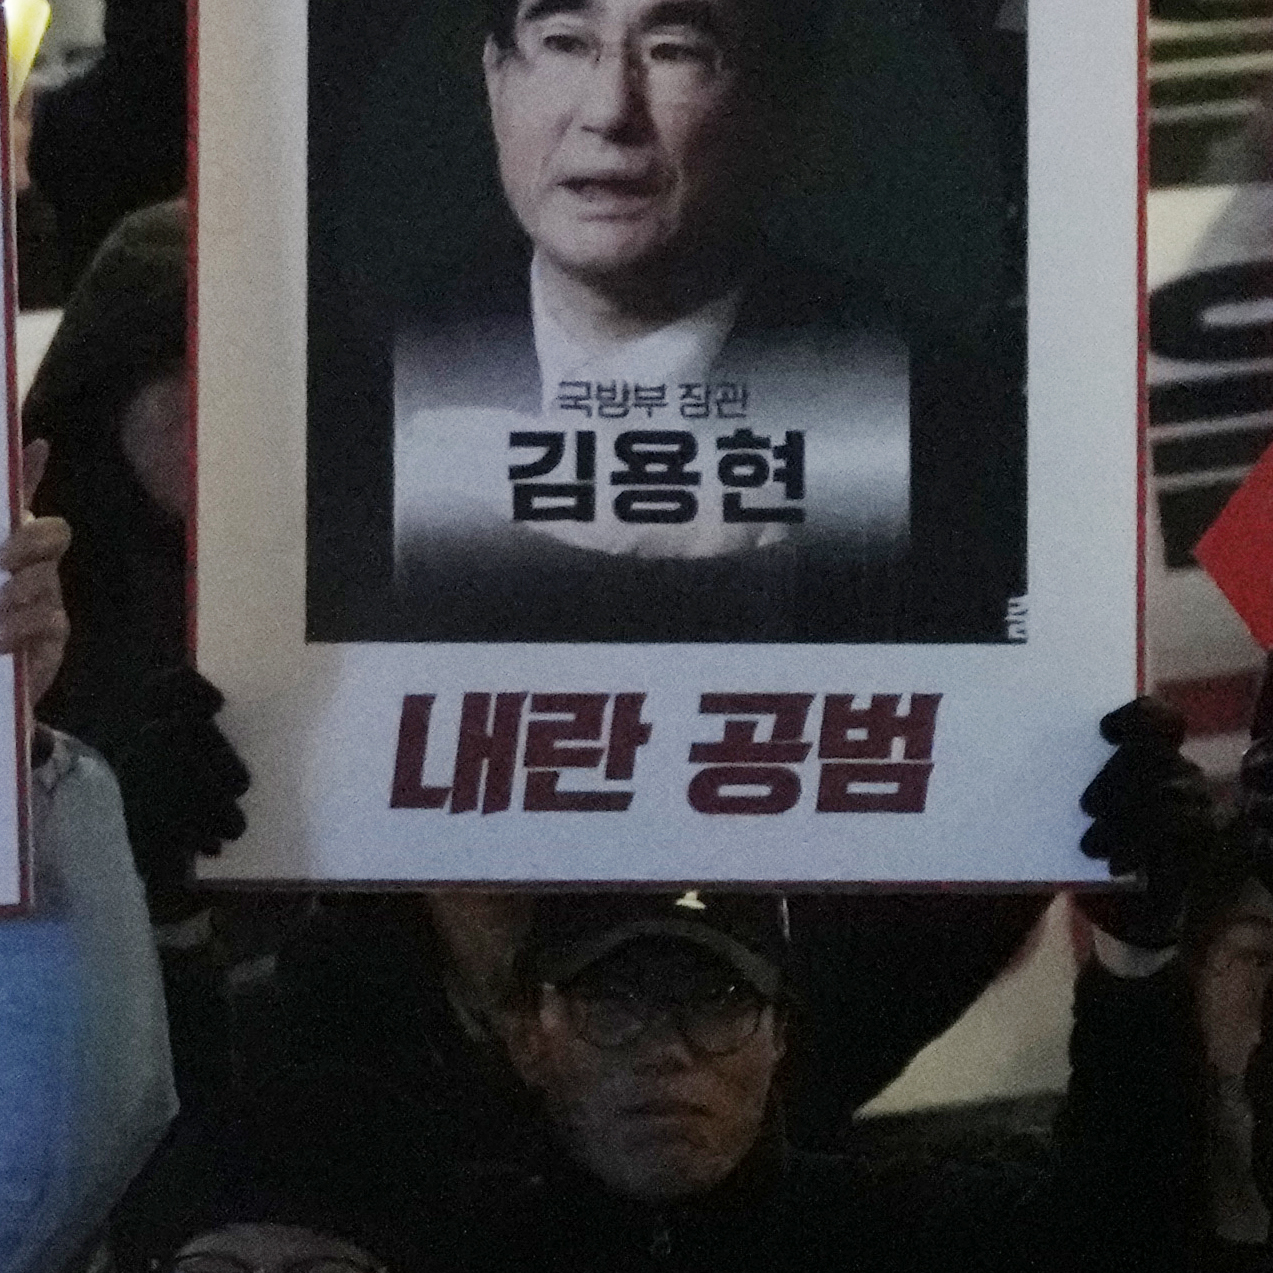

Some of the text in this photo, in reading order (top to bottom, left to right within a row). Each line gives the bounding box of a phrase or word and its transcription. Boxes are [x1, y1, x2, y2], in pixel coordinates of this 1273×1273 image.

[559, 381, 748, 419] 국방부 장관
[508, 428, 806, 524] 김용현
[389, 691, 944, 817] 내란 공범
